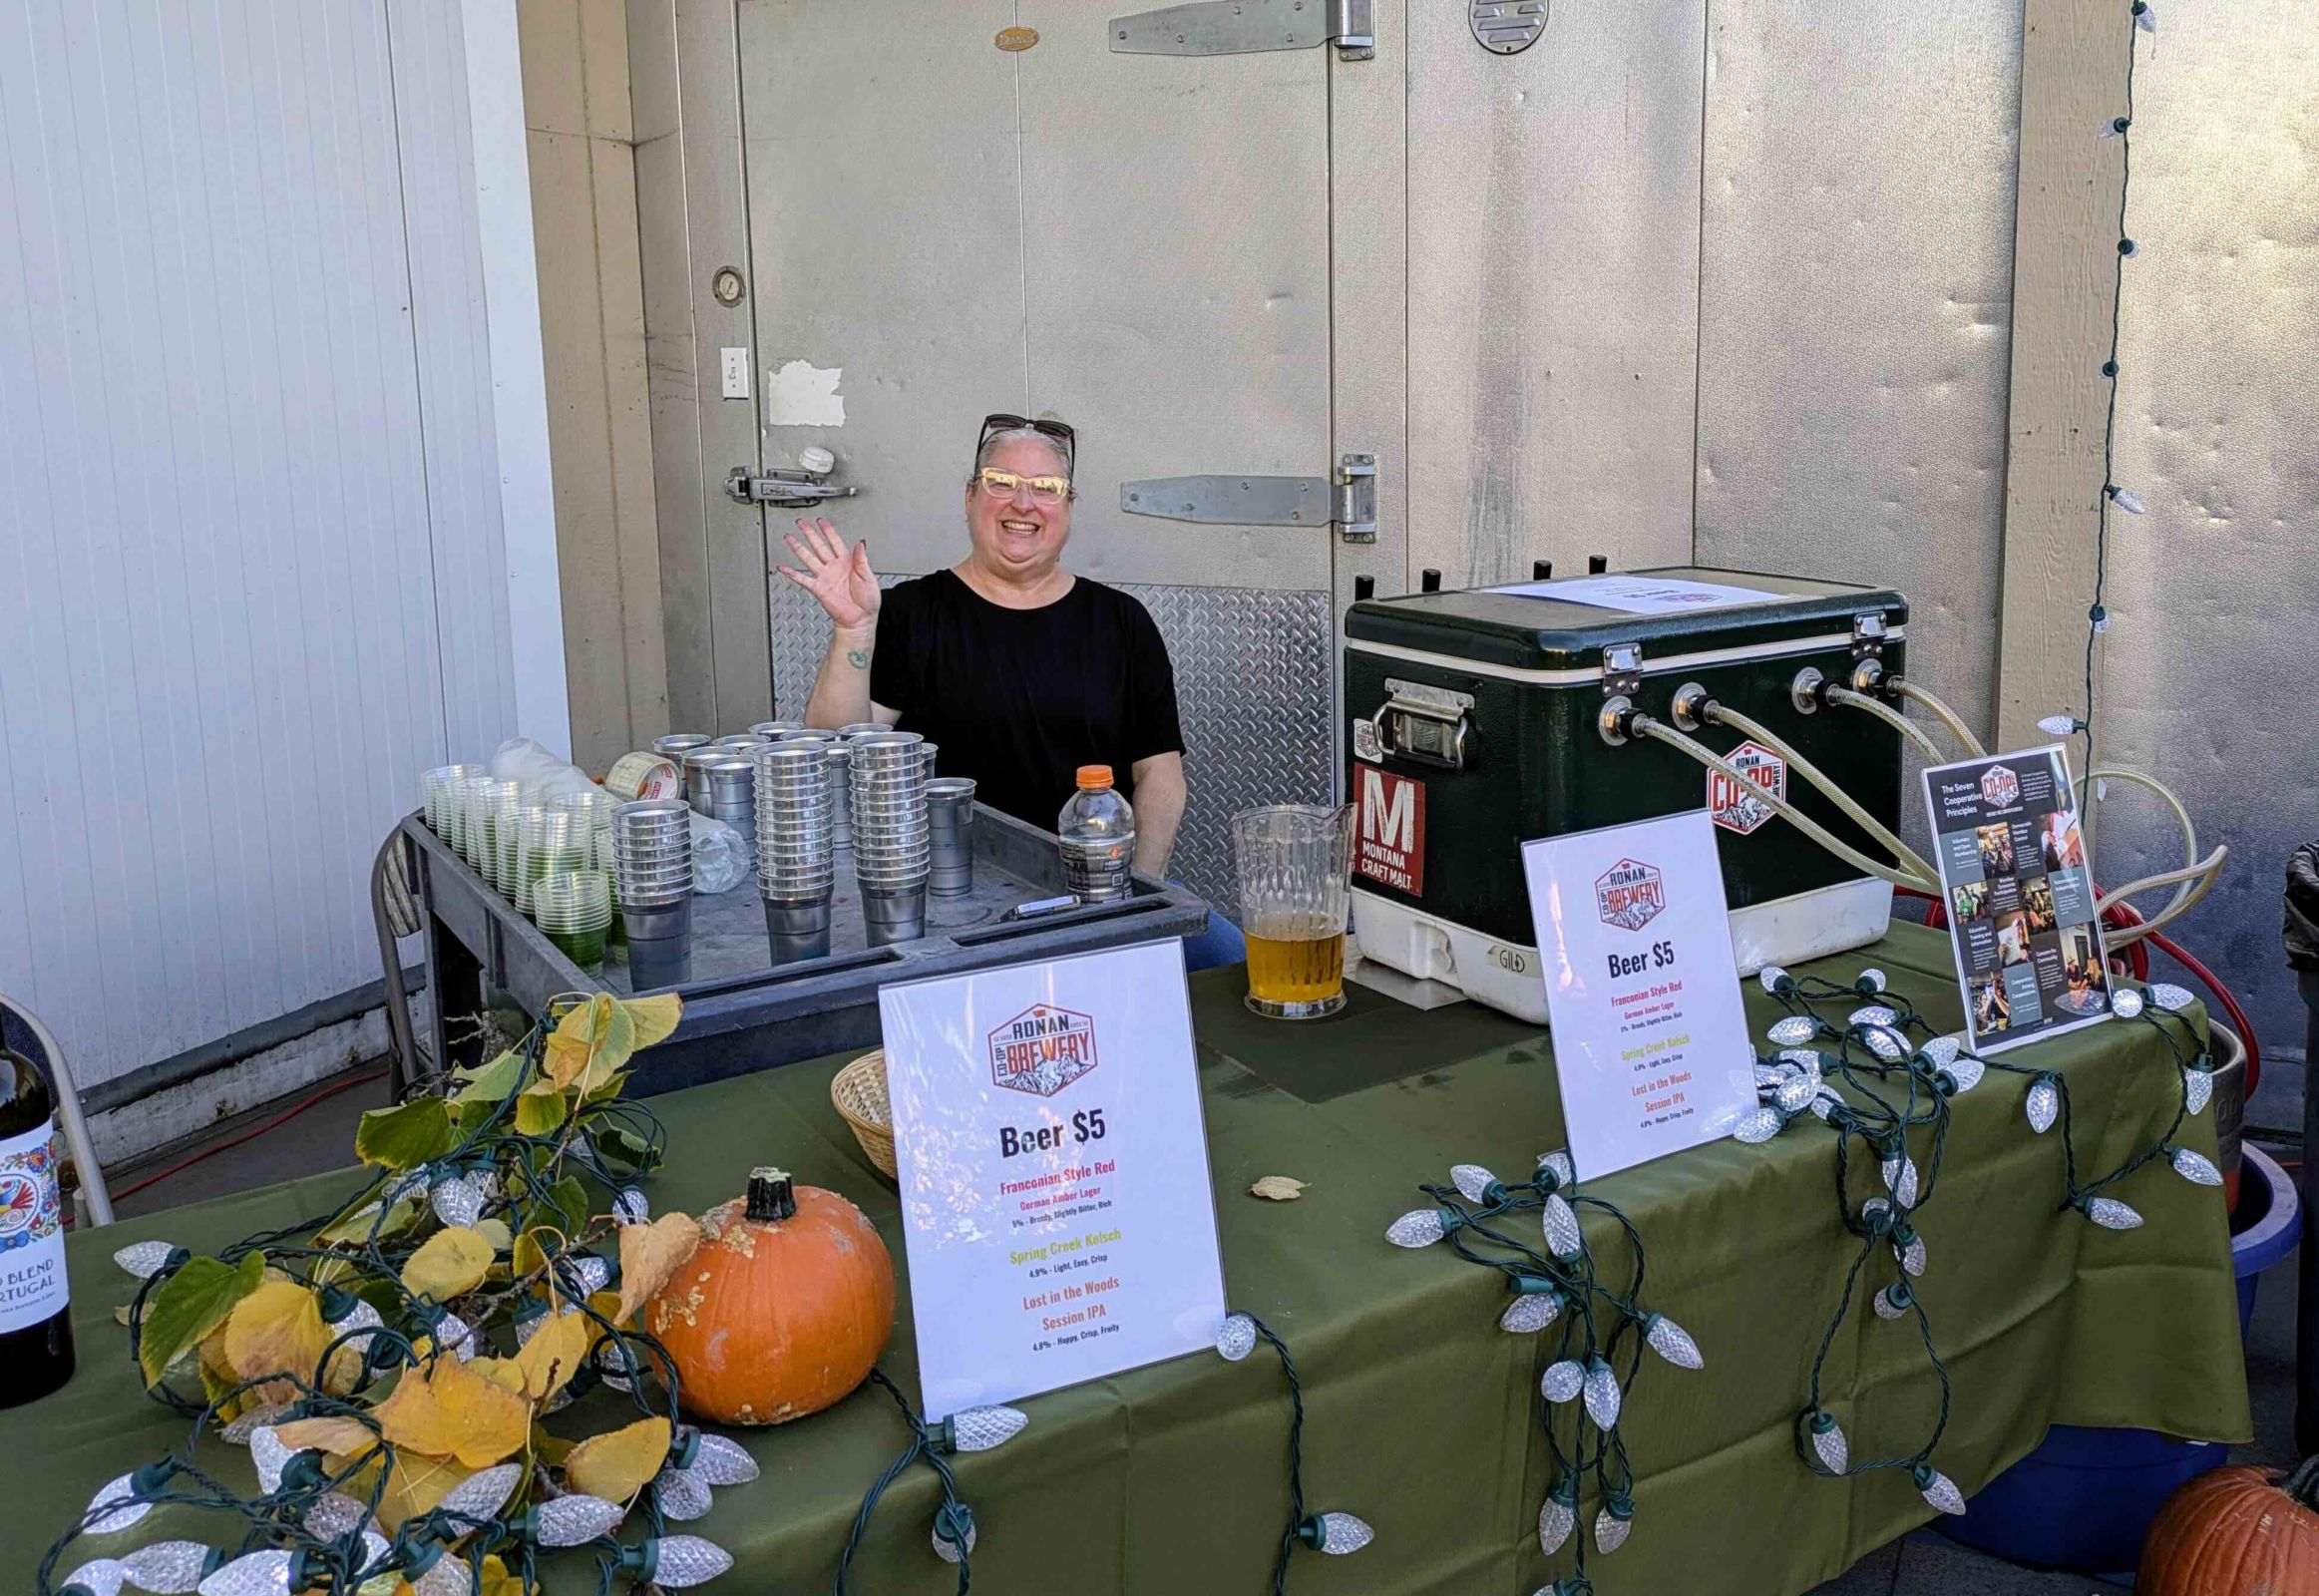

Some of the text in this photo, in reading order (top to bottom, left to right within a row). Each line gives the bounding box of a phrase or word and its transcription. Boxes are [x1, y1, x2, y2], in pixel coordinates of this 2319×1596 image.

[1736, 755, 1760, 768] RONAN
[1714, 765, 1772, 812] COP
[1942, 782, 1975, 794] The Seven
[1944, 793, 1983, 806] Cooperative
[1984, 775, 2012, 798] CO-OP
[1363, 768, 1414, 854] M
[1946, 806, 1978, 818] Principles
[1363, 840, 1405, 870] MONTANA
[1361, 858, 1412, 890] CRAFT MALT
[1610, 867, 1646, 887] RONAN
[1607, 881, 1660, 914] BREWERY
[1608, 941, 1675, 979] Beer $5
[1611, 980, 1683, 1007] Franconian Style Red
[1012, 1014, 1069, 1039] RONAN
[994, 1047, 1007, 1076] CO-OP
[1006, 1031, 1089, 1074] BREWERY
[1621, 1048, 1645, 1062] Spring
[1632, 1071, 1692, 1097] Lost in the Woods
[1645, 1092, 1685, 1113] Session IPA
[999, 1108, 1106, 1159] Beer $5
[1000, 1159, 1115, 1195] Franconian Style Red
[1020, 1187, 1101, 1211] German Amber Lager
[1012, 1219, 1024, 1228] 5%
[1054, 1208, 1077, 1220] Slightly
[1009, 1248, 1047, 1266] Spring
[1050, 1238, 1082, 1255] Creek
[8, 1259, 54, 1285] BLEND
[1029, 1268, 1047, 1278] 4.9%
[1053, 1262, 1072, 1273] Light,
[1090, 1254, 1108, 1264] Crisp
[1023, 1277, 1119, 1310] Lost in the Woods
[1042, 1304, 1106, 1331] Session IPA
[1032, 1341, 1051, 1352] 4.8%
[1100, 1324, 1119, 1335] Fruity
